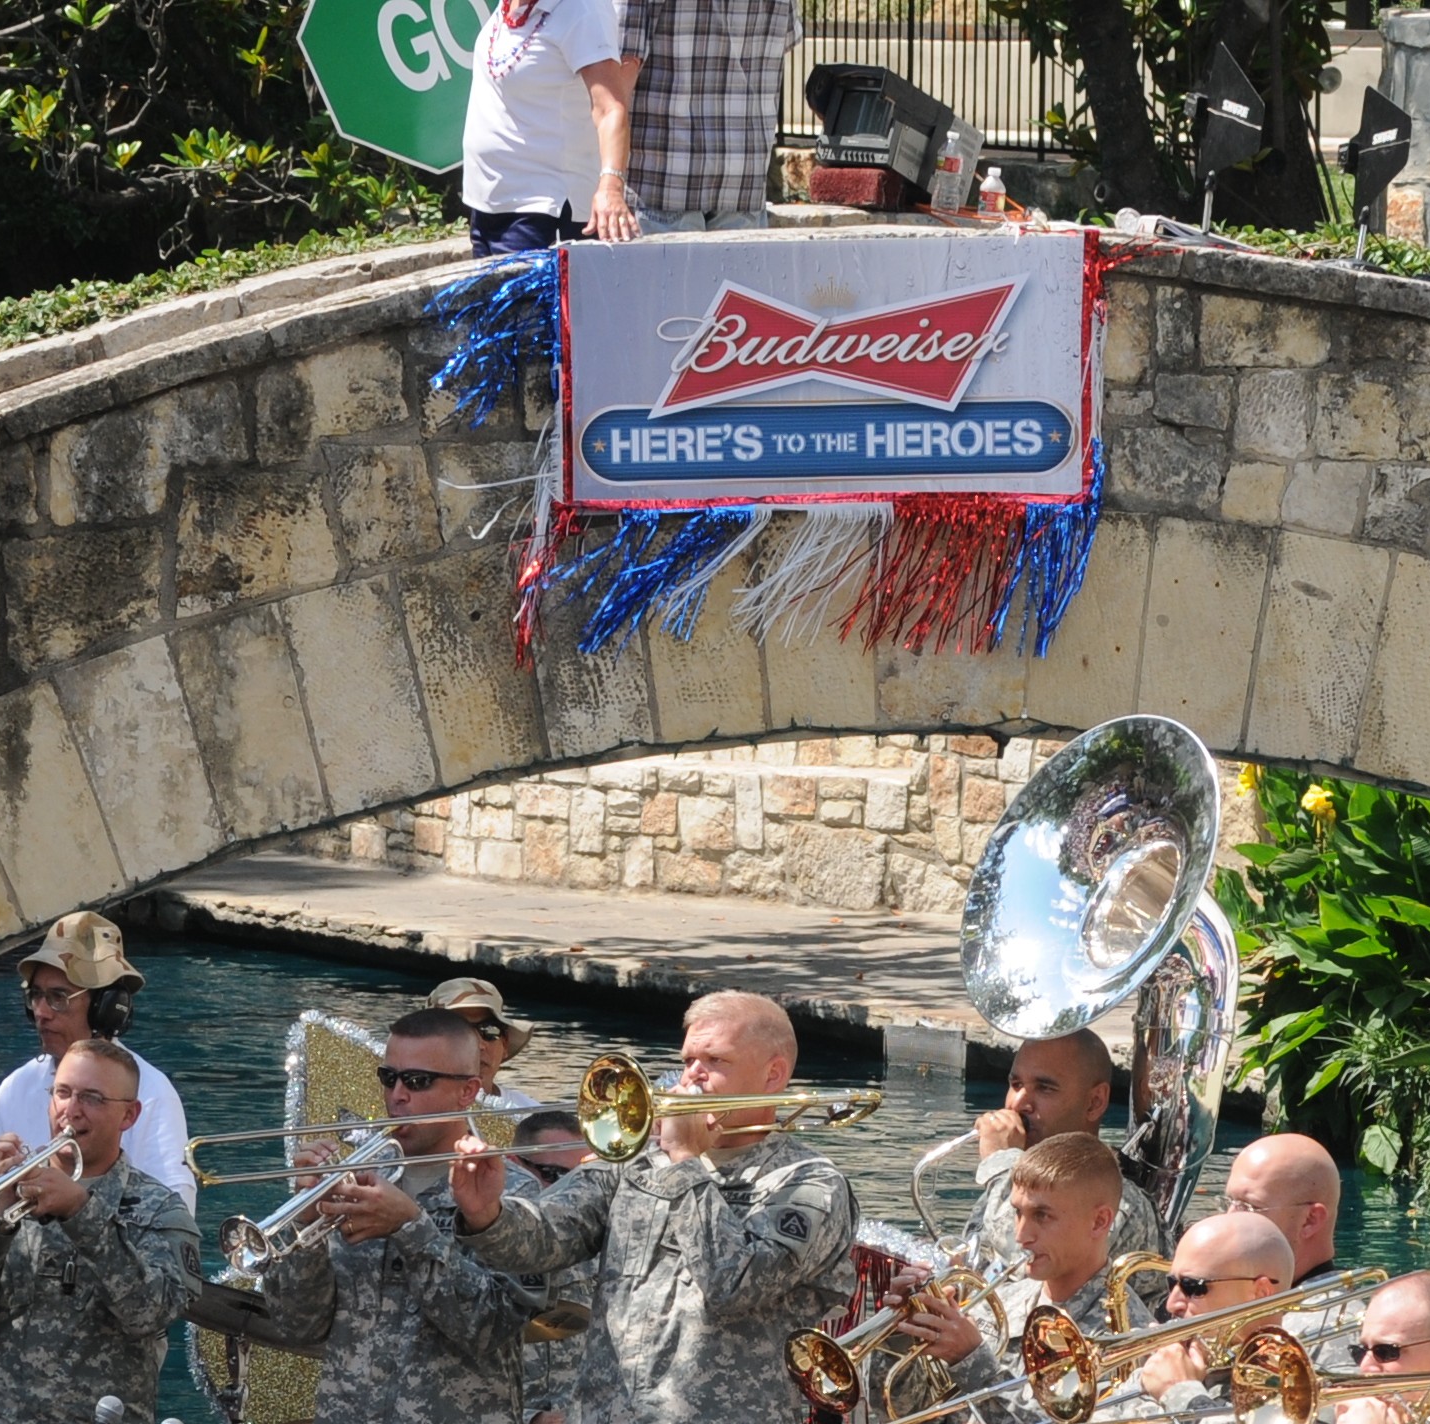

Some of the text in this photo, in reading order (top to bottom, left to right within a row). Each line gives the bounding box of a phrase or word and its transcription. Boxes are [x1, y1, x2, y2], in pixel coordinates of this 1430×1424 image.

[377, 0, 493, 92] GO
[656, 313, 1010, 374] Budweiser
[609, 419, 1043, 465] HERE'S TO THE HEROES
